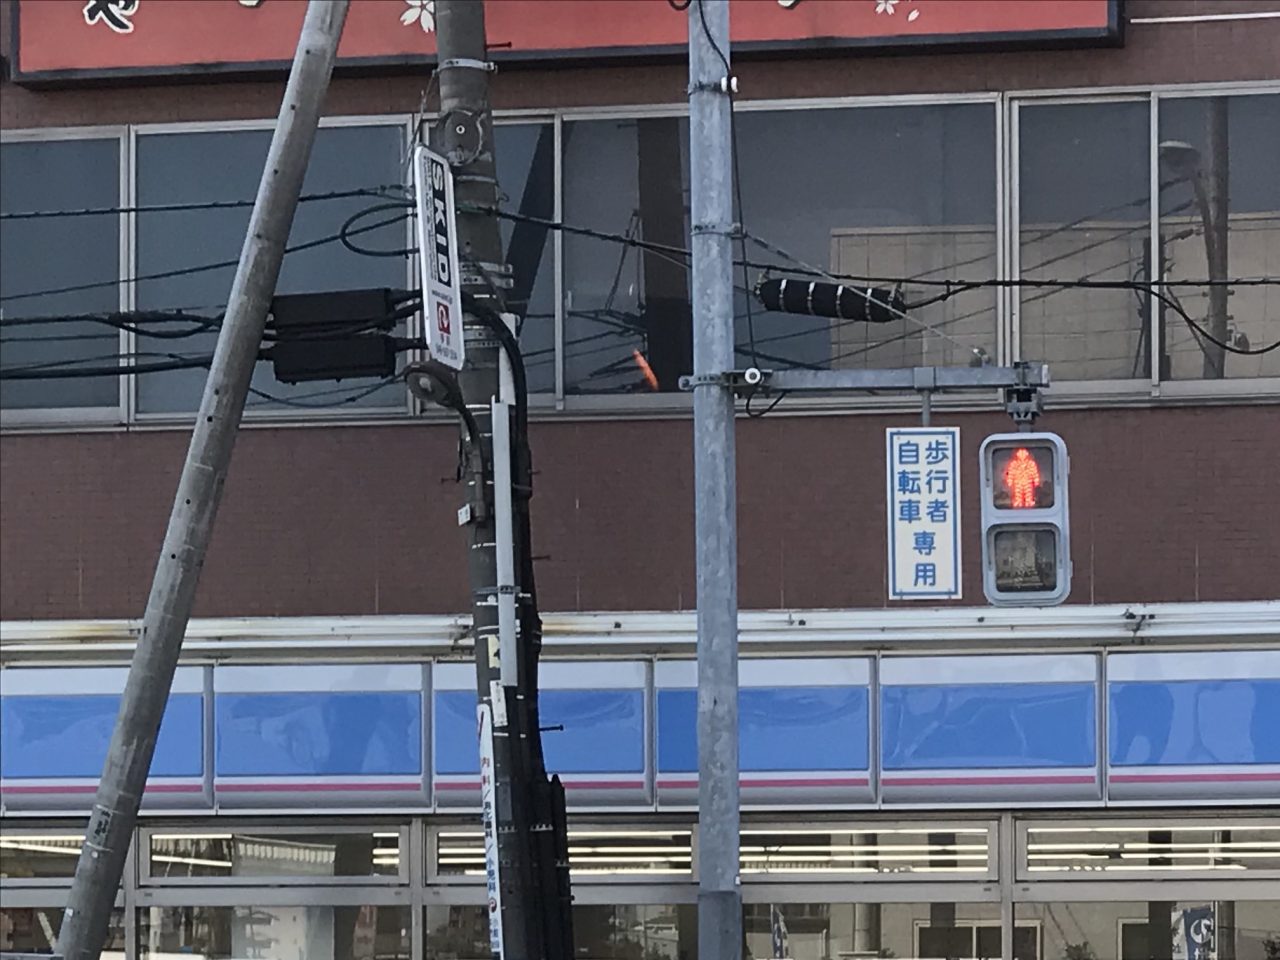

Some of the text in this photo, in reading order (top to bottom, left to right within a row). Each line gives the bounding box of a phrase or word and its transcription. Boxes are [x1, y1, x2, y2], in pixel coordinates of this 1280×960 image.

[432, 163, 450, 284] SKID
[897, 440, 922, 524] 自転車
[925, 439, 949, 524] 歩行者
[912, 530, 936, 587] 専用
